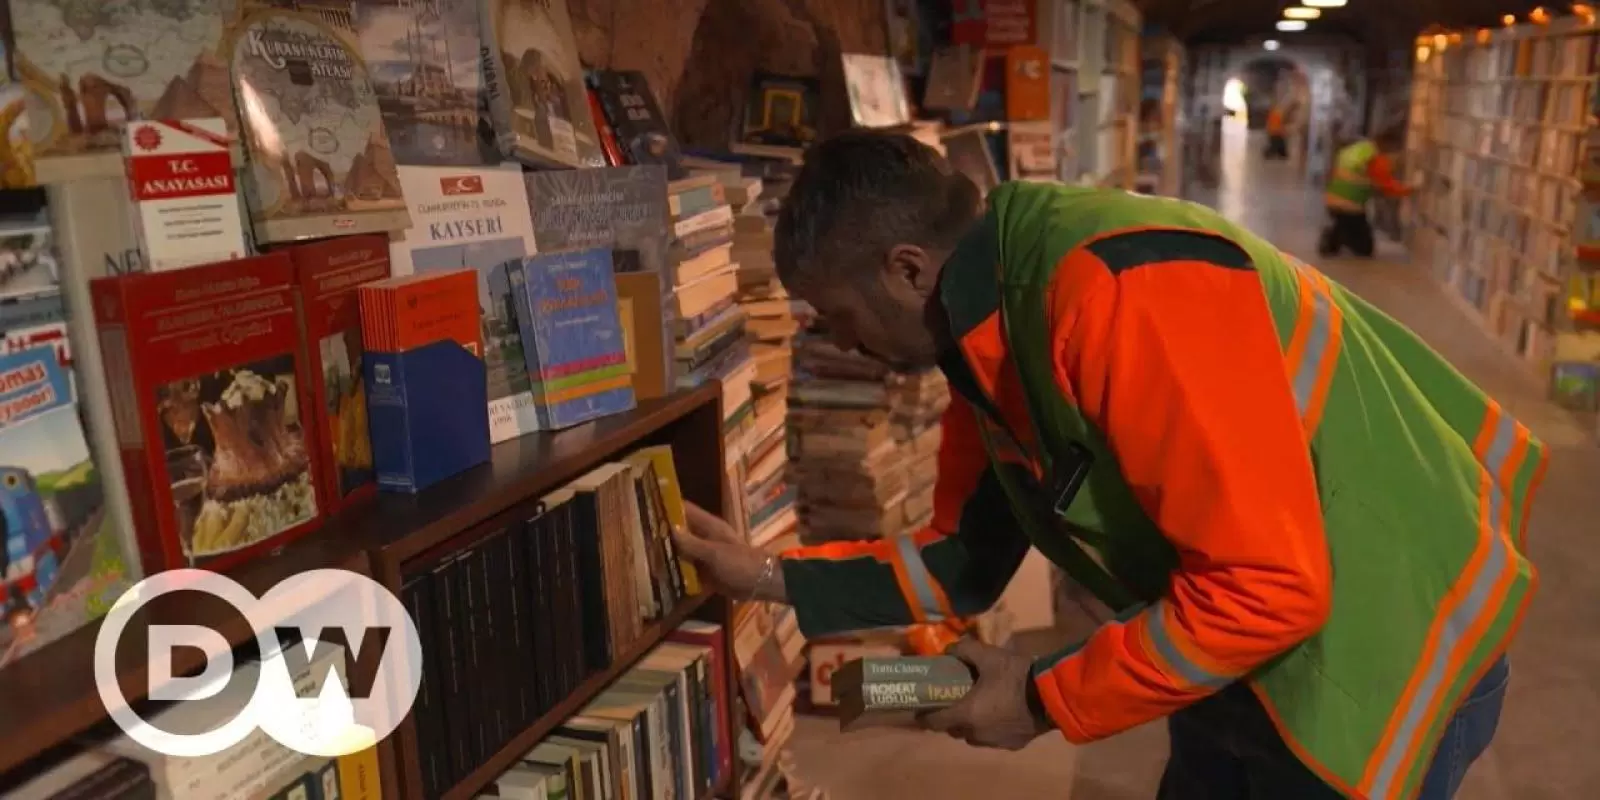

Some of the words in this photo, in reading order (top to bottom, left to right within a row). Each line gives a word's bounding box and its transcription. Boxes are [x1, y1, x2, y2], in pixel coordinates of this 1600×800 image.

[168, 159, 199, 174] T.C.
[143, 174, 229, 195] ANAYASASI
[894, 662, 930, 676] Clancy
[870, 682, 917, 694] ROBERT
